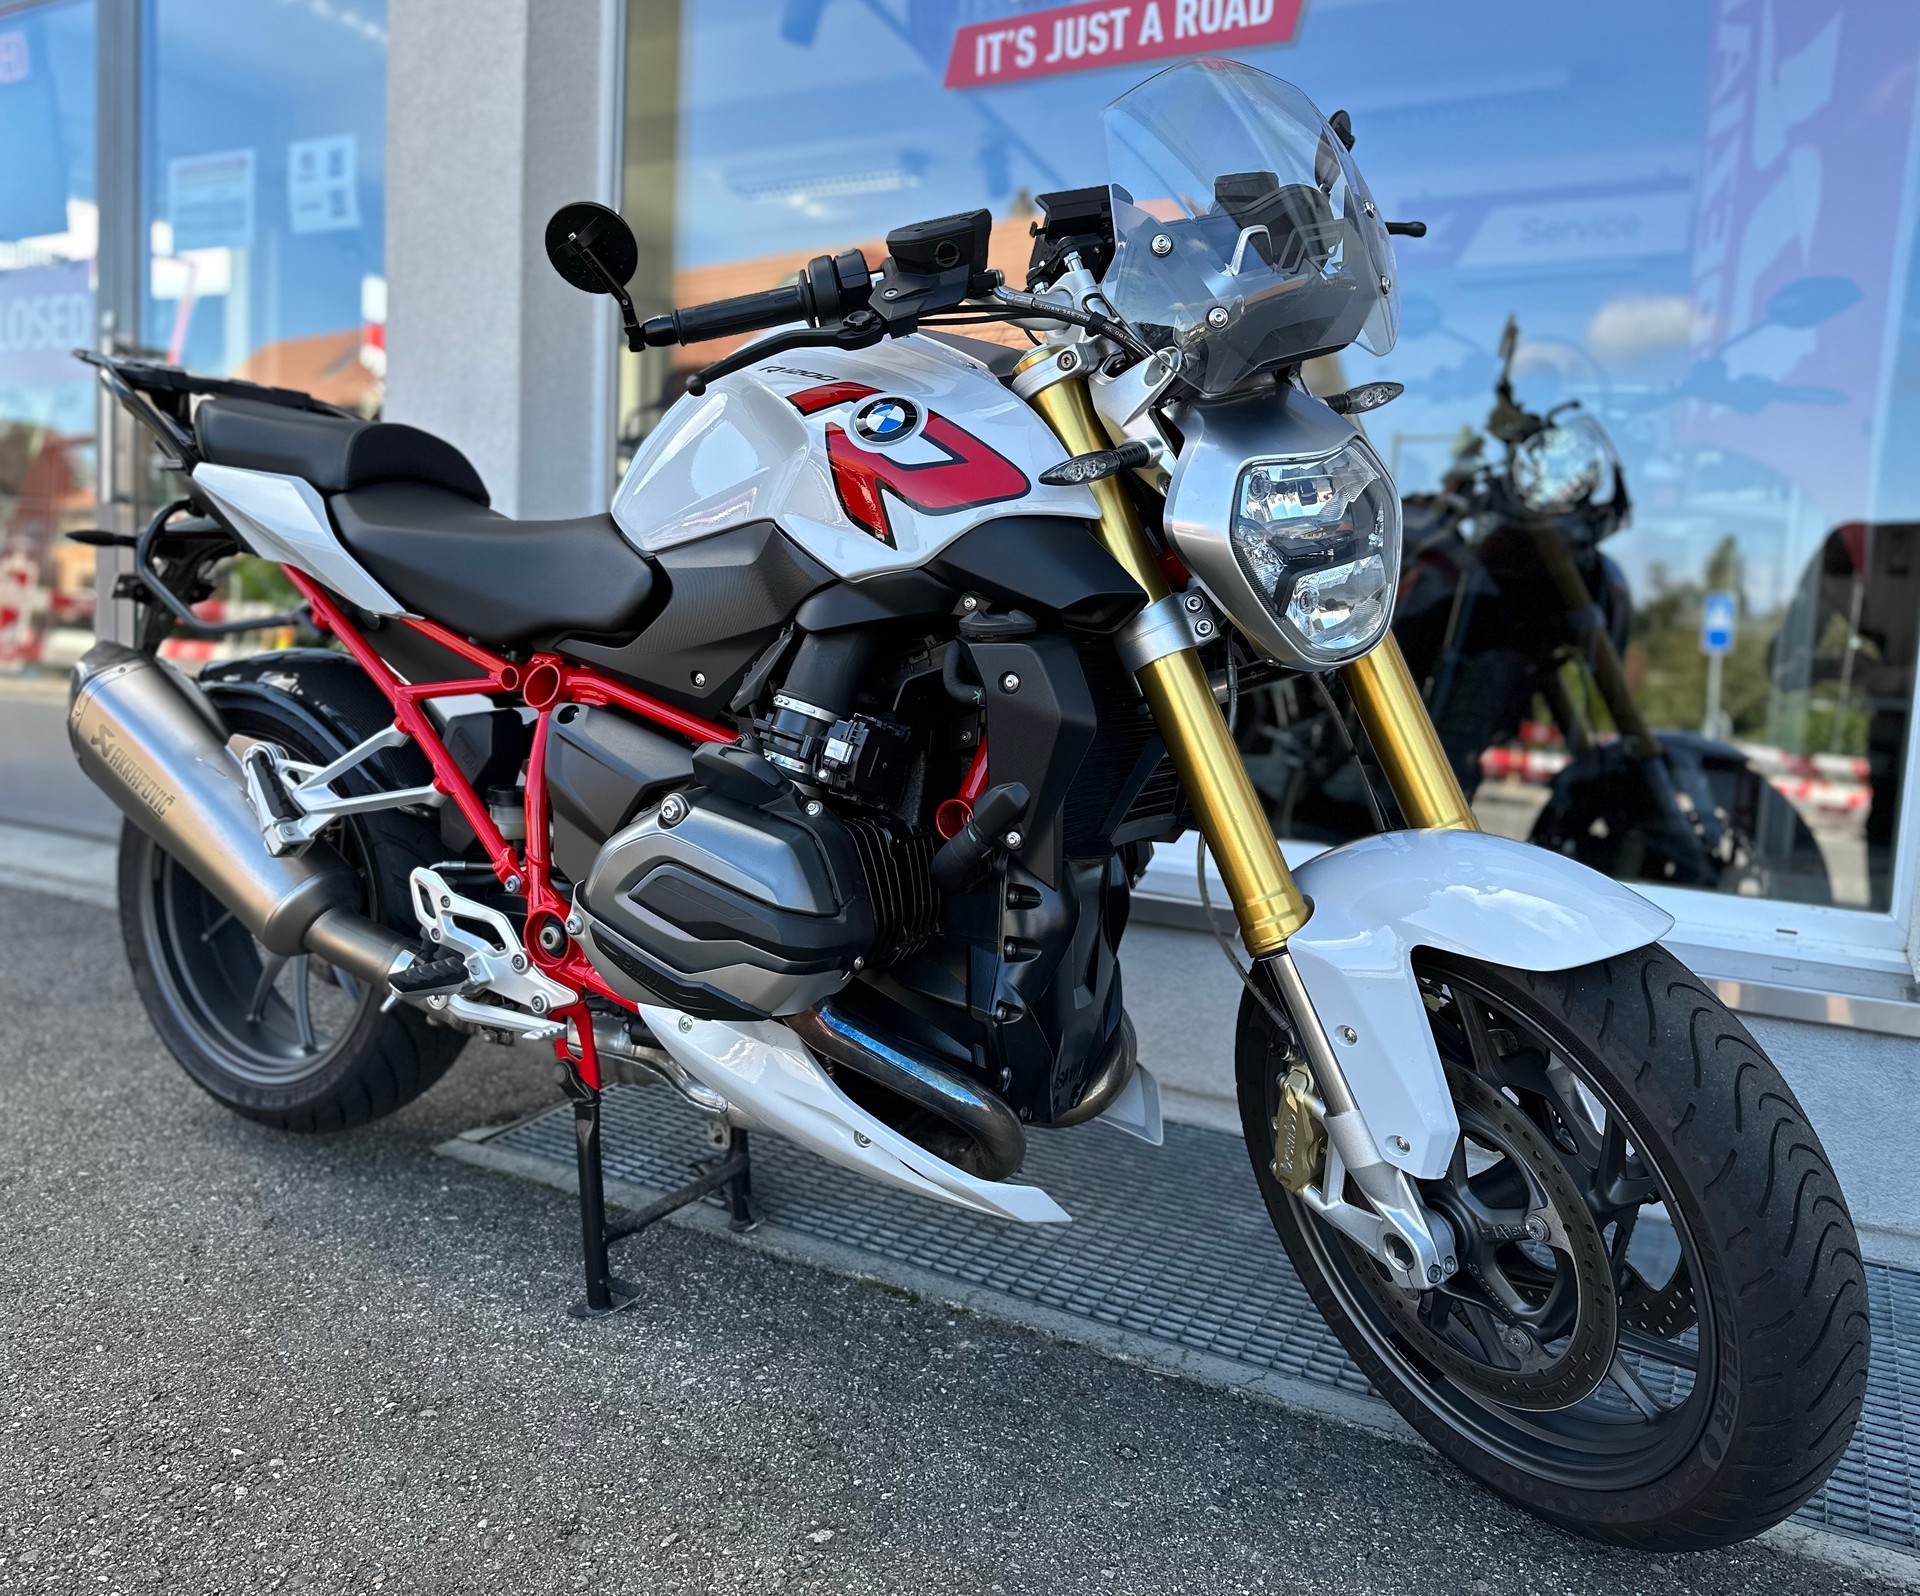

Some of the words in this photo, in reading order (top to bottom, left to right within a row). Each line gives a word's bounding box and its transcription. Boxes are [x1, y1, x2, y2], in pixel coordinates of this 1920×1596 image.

[975, 25, 1037, 76] IT'S
[1045, 7, 1131, 63] JUST
[1137, 1, 1164, 46] A
[1174, 0, 1274, 40] ROAD
[1519, 213, 1642, 247] Service
[109, 748, 176, 817] AKRAPOVIČ
